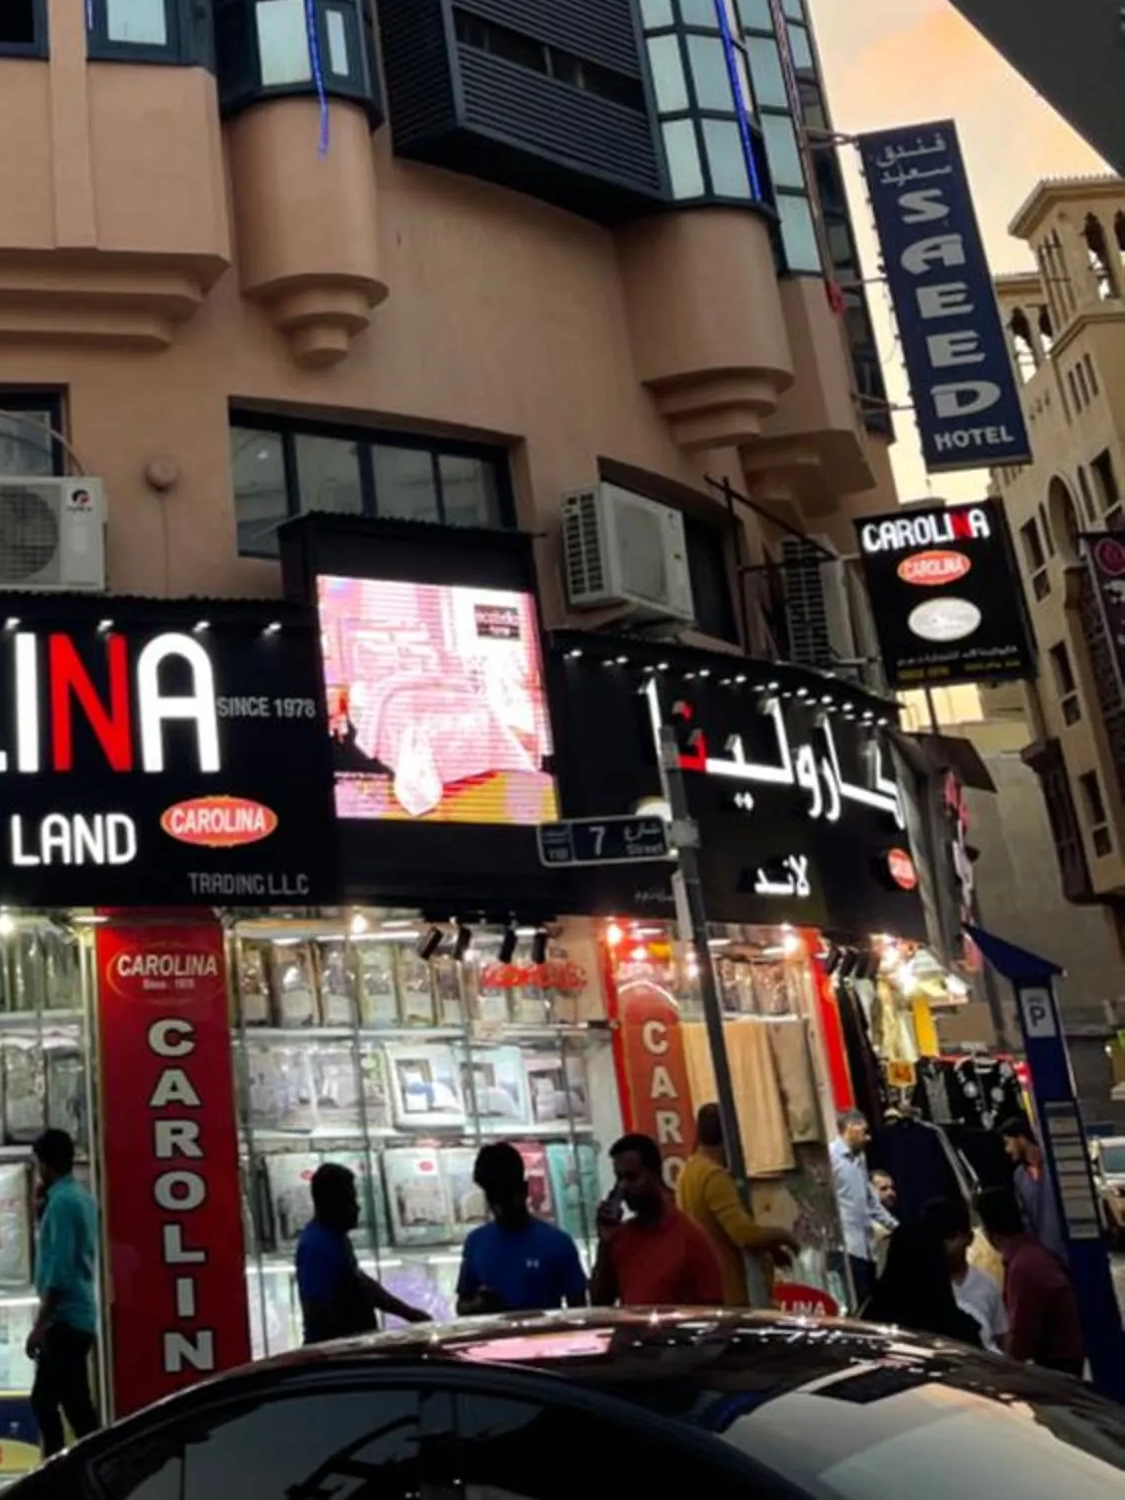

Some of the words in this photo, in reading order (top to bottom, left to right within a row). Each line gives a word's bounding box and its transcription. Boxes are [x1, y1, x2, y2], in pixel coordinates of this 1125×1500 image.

[898, 188, 1002, 419] SAEED
[934, 425, 1015, 452] HOTEL
[861, 508, 991, 553] CAROLINA
[216, 696, 271, 717] SINCE
[275, 698, 316, 717] 1978
[169, 806, 267, 835] CAROLINA
[11, 813, 138, 866] LAND
[588, 824, 606, 857] 7
[187, 871, 265, 896] TRADING
[117, 953, 219, 978] CAROLINA
[147, 1018, 215, 1373] CAROLIN
